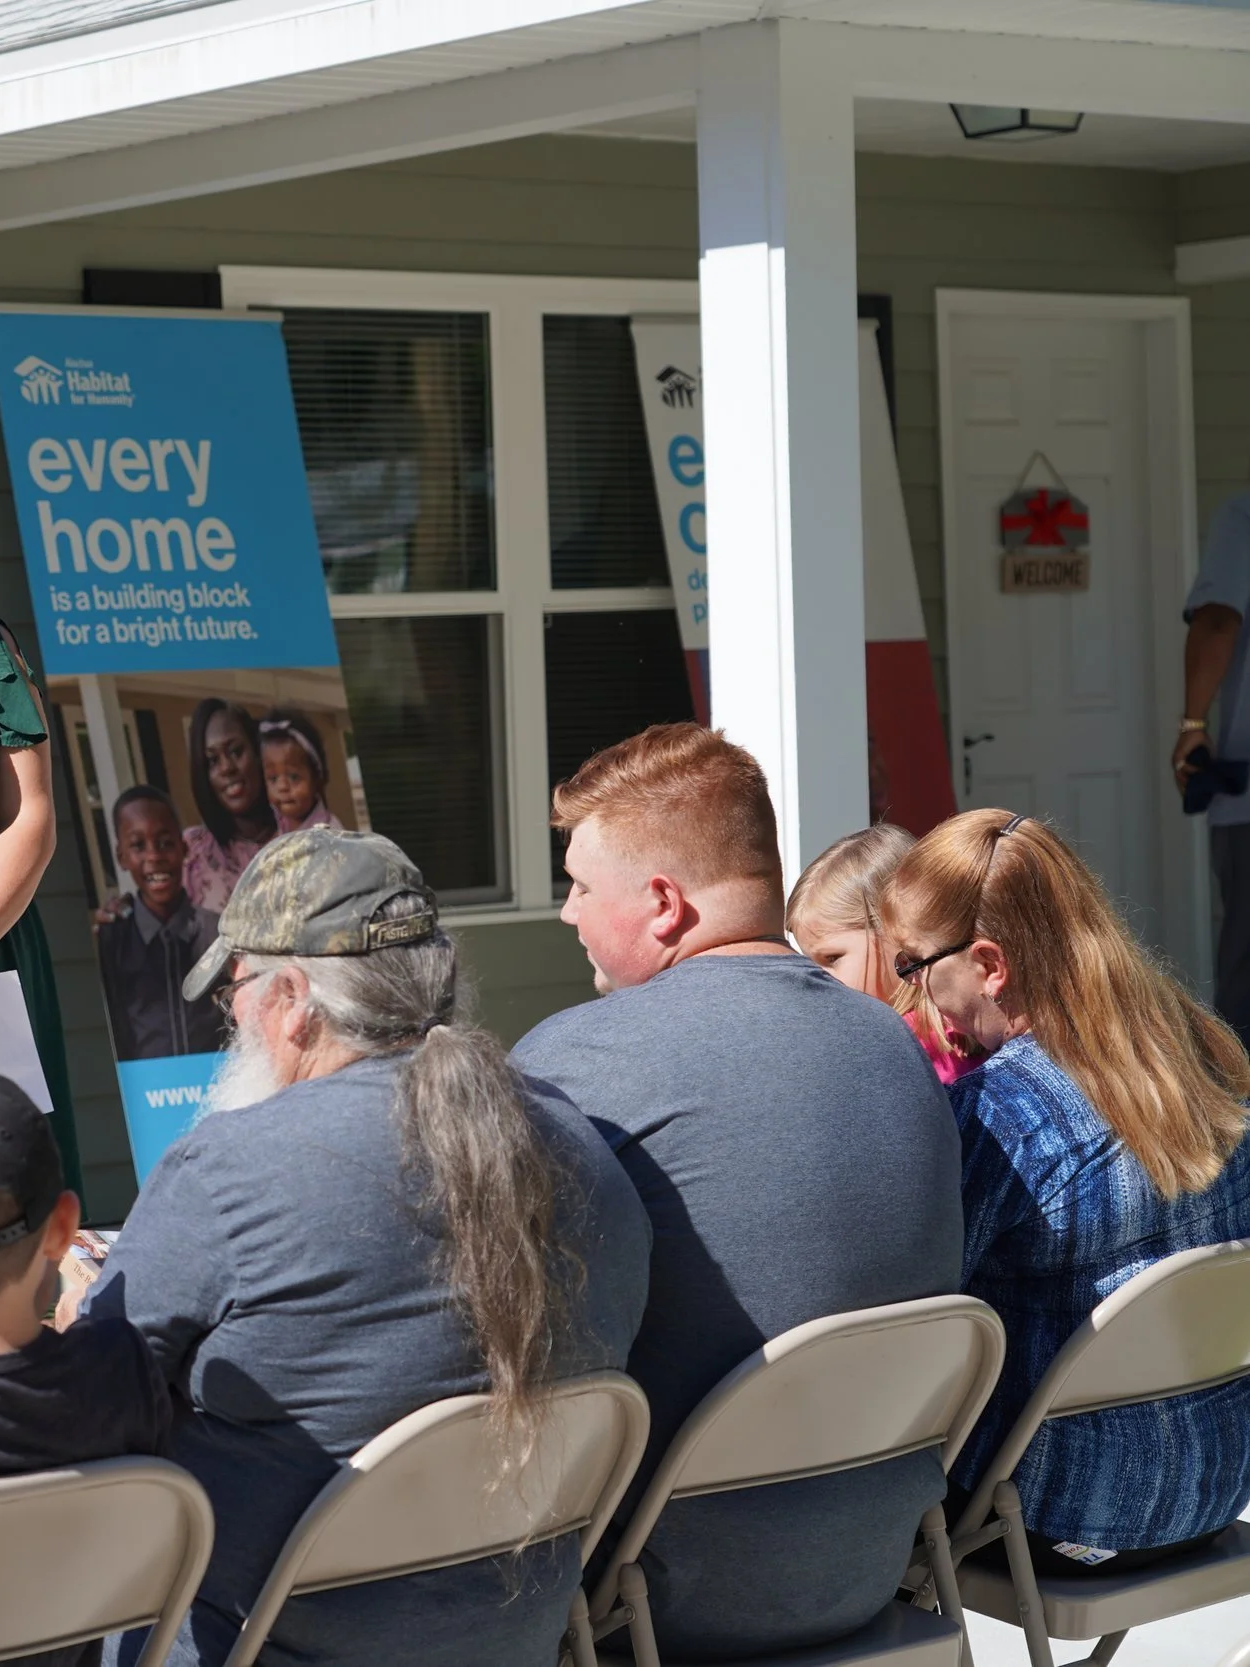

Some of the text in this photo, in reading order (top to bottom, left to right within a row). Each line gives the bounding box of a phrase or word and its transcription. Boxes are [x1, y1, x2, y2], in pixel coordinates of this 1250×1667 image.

[66, 370, 131, 392] Habitat
[28, 437, 211, 507] every
[37, 500, 237, 573] home
[1013, 559, 1084, 586] WELCOME
[50, 581, 251, 614] is a building block
[56, 615, 258, 647] for a bright future.
